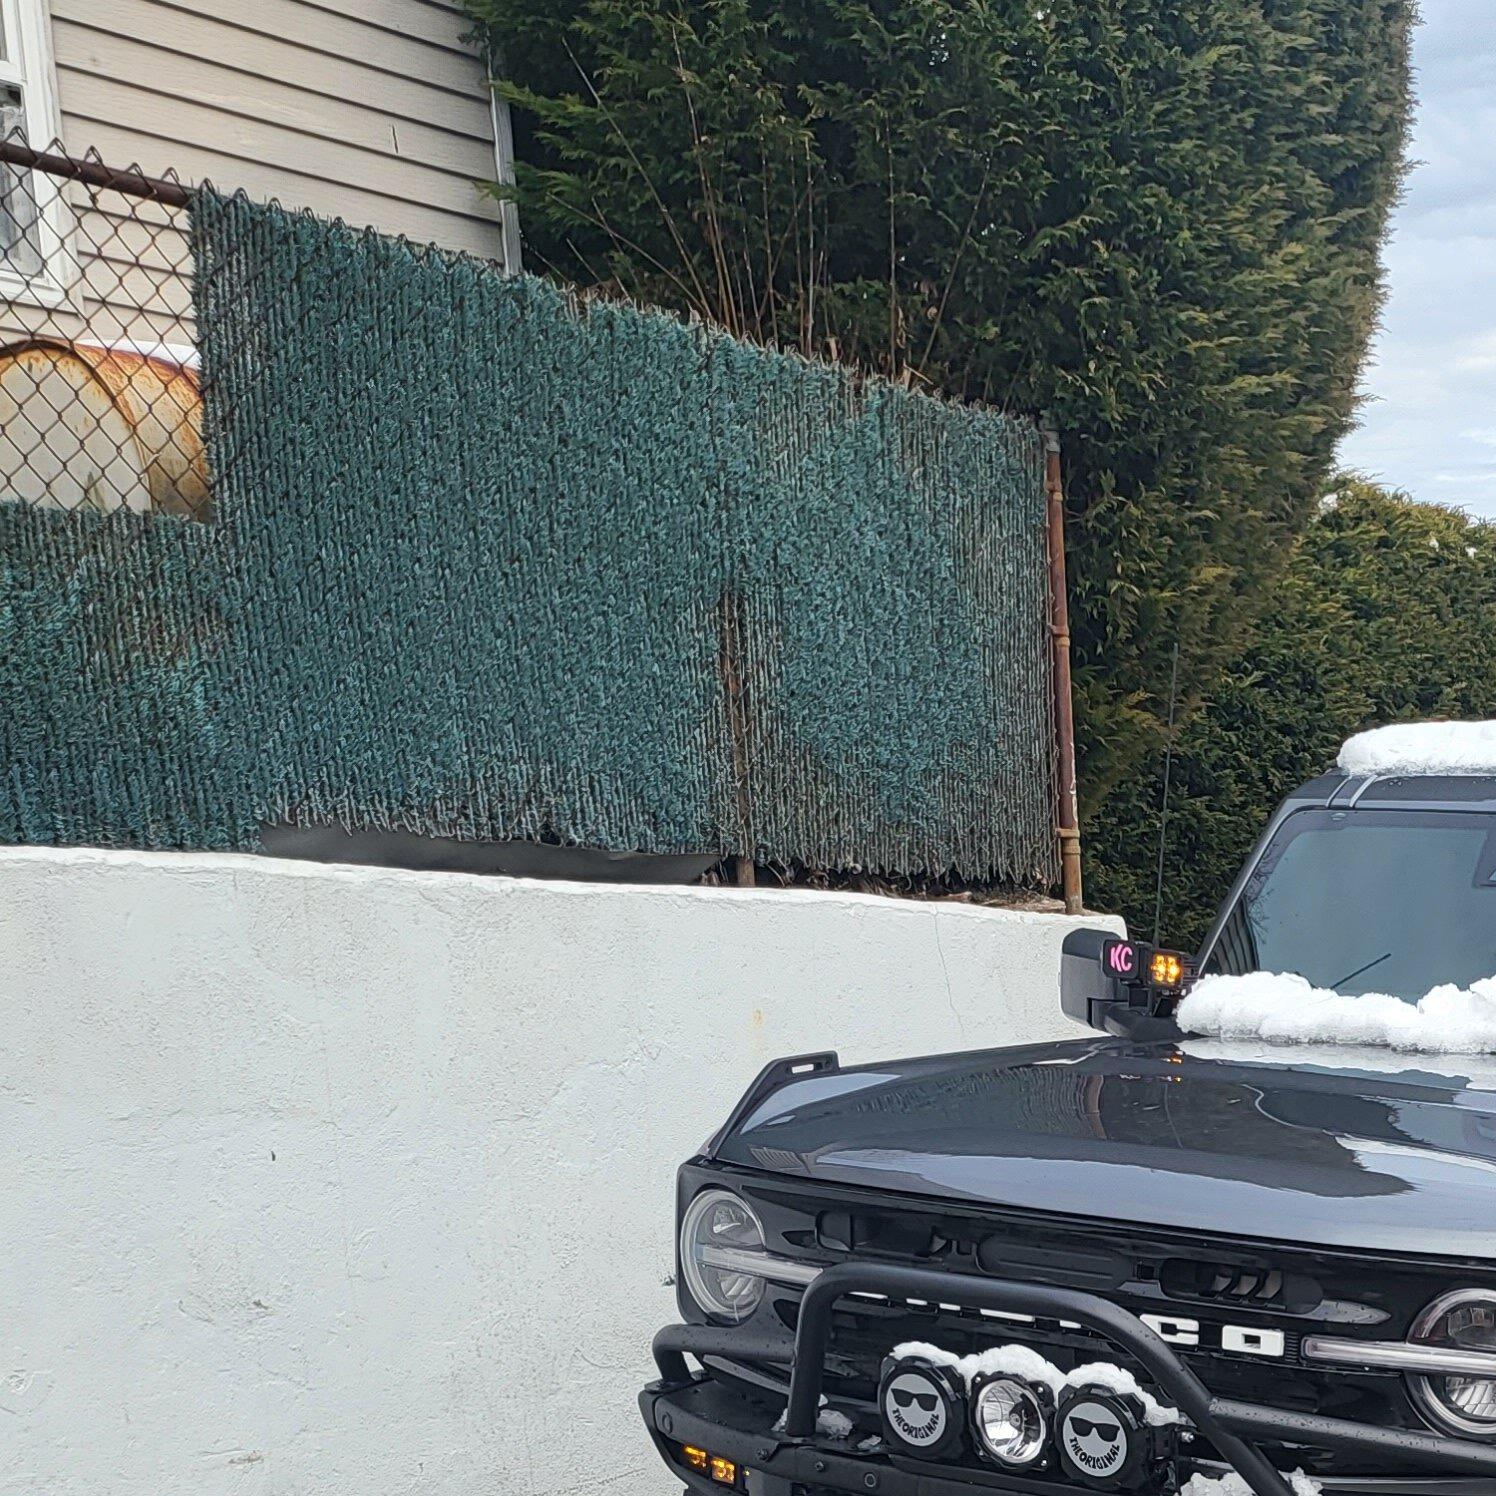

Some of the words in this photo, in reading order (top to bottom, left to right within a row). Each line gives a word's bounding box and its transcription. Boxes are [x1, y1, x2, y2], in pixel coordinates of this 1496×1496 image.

[1110, 943, 1133, 972] KC
[892, 1407, 906, 1427] THE
[902, 1413, 940, 1439] ORIGINAL
[1069, 1436, 1084, 1456] THE
[1079, 1444, 1120, 1470] ORIGINAL
